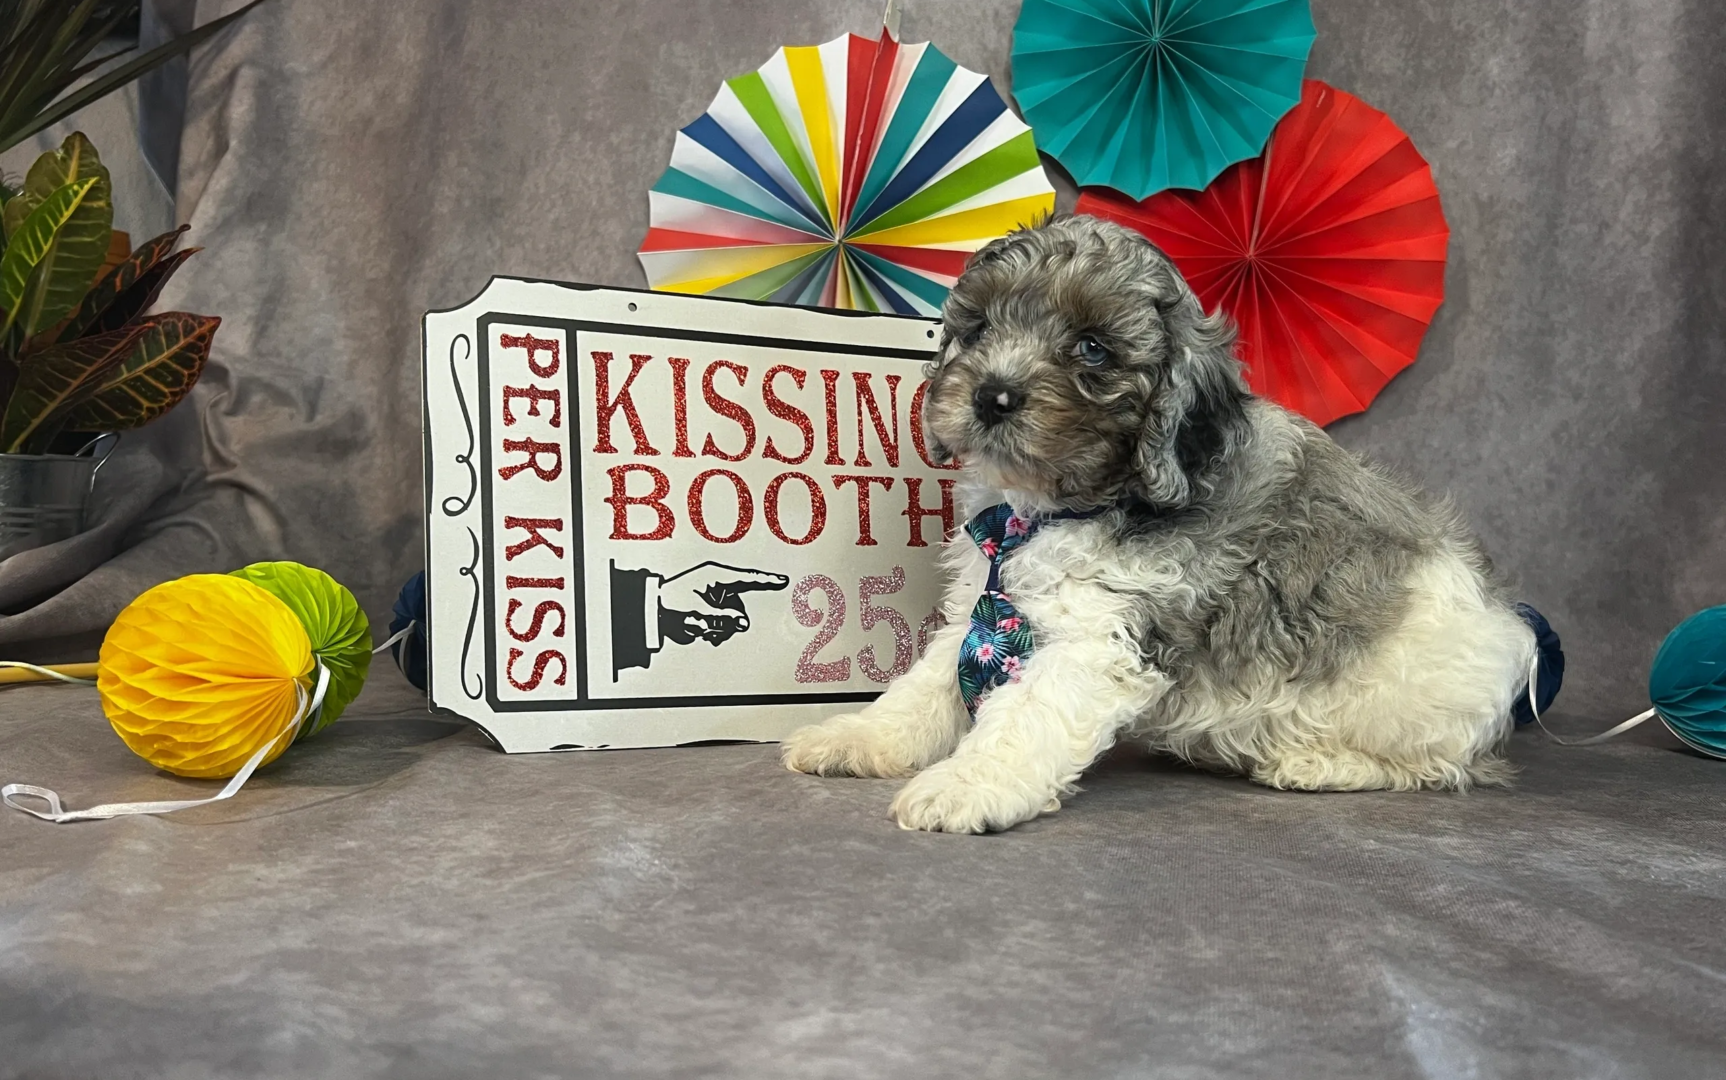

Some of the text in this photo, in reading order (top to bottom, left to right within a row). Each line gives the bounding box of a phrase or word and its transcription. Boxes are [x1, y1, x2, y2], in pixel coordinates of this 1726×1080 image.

[498, 333, 567, 691] PER KISS
[603, 463, 957, 548] BOOTH
